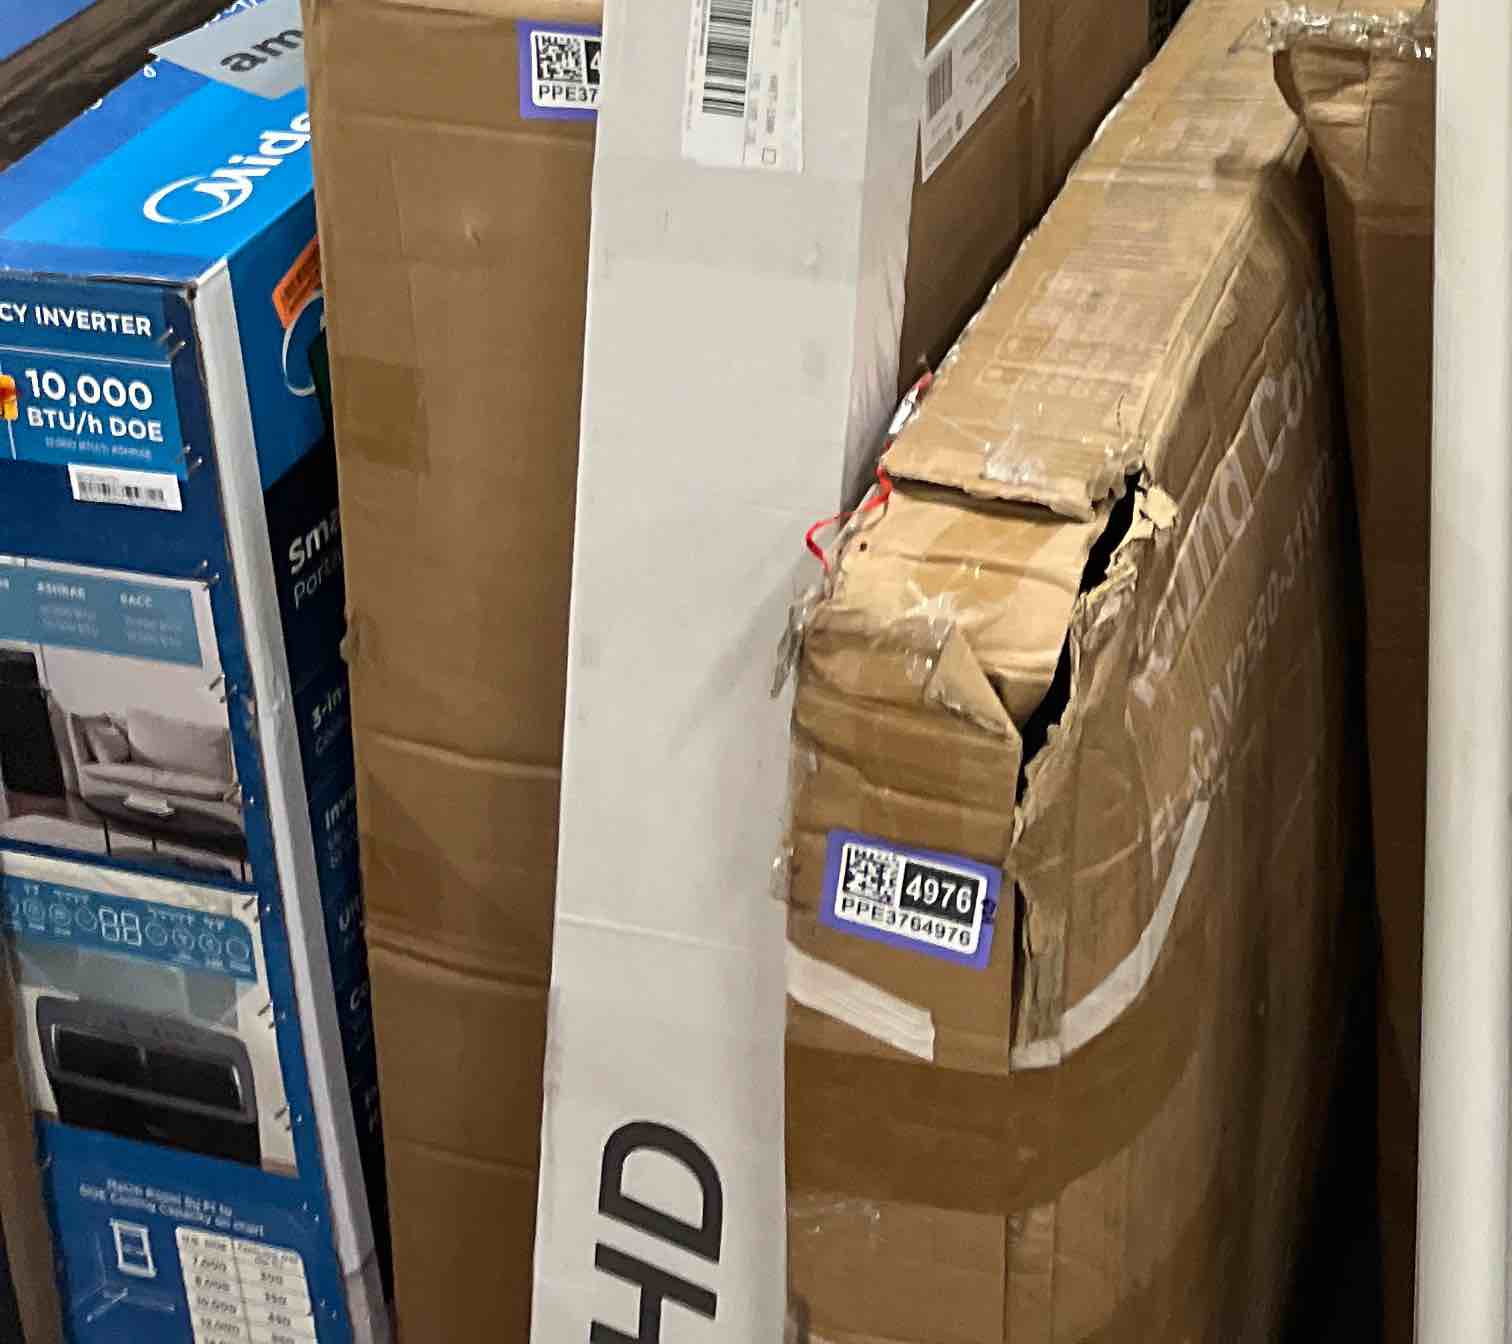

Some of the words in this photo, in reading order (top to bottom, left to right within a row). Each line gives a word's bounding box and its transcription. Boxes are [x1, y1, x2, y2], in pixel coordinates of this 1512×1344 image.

[35, 305, 152, 337] INVERTER
[25, 367, 153, 411] 10,000
[27, 406, 104, 436] BTU/h
[109, 415, 165, 443] DOE
[905, 873, 972, 913] 4976
[841, 897, 971, 946] PPE3764976
